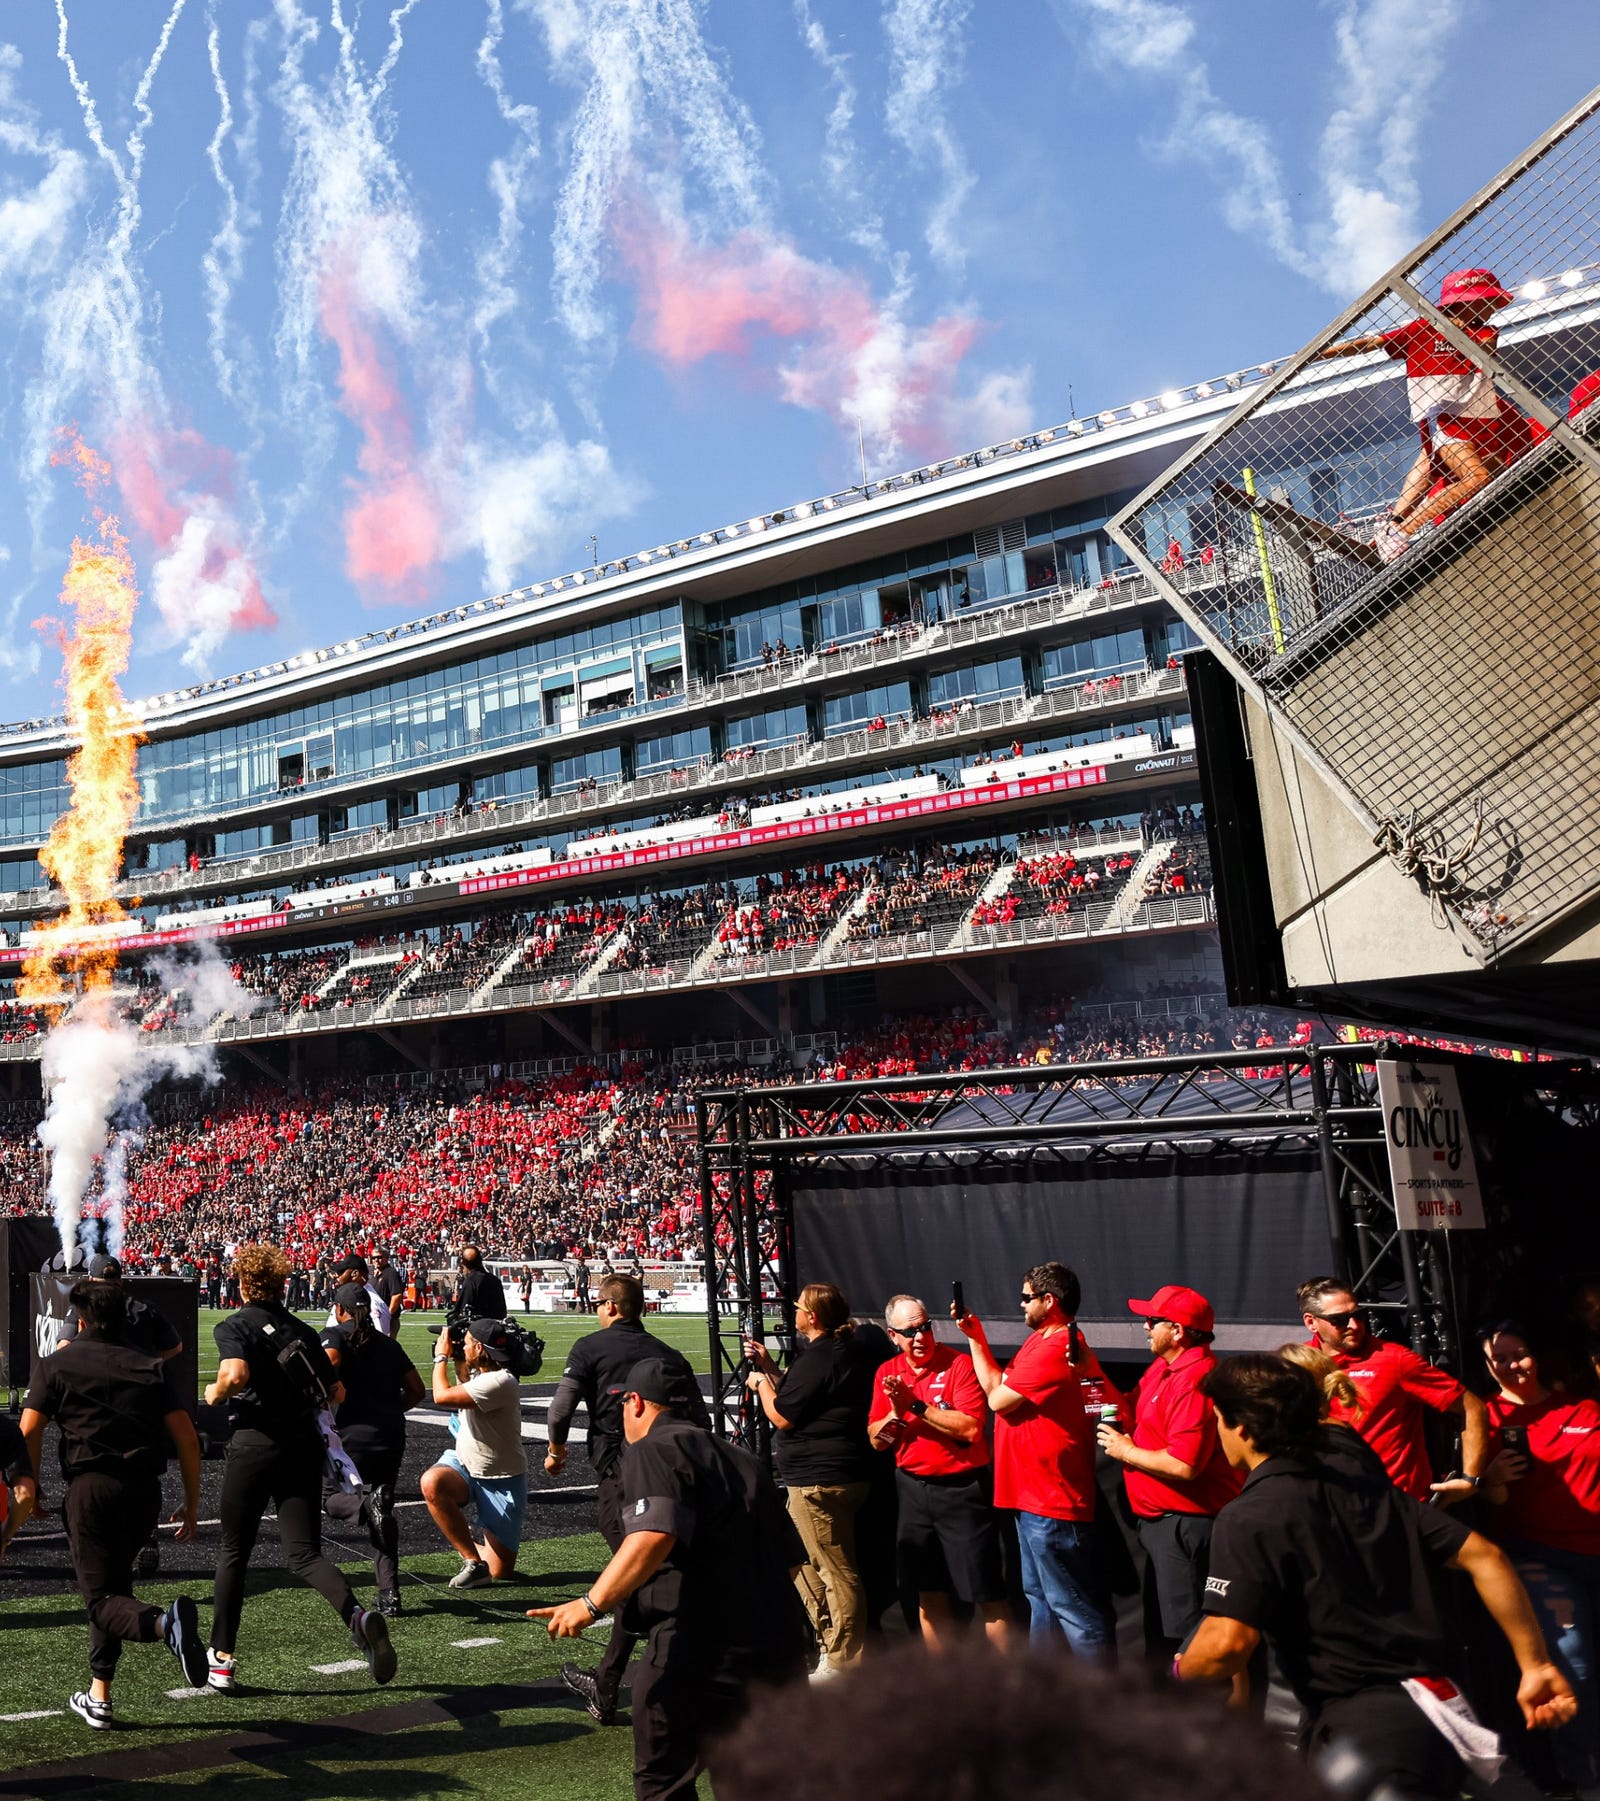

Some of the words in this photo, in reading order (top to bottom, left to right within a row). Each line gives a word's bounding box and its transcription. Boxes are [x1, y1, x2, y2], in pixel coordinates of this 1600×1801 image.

[384, 894, 400, 906] 3:40
[1390, 1103, 1463, 1171] CINCY
[1407, 1179, 1431, 1189] SPORTS
[1432, 1179, 1464, 1189] PARTNERS
[1417, 1200, 1445, 1217] SUITE
[1447, 1200, 1463, 1217] #8
